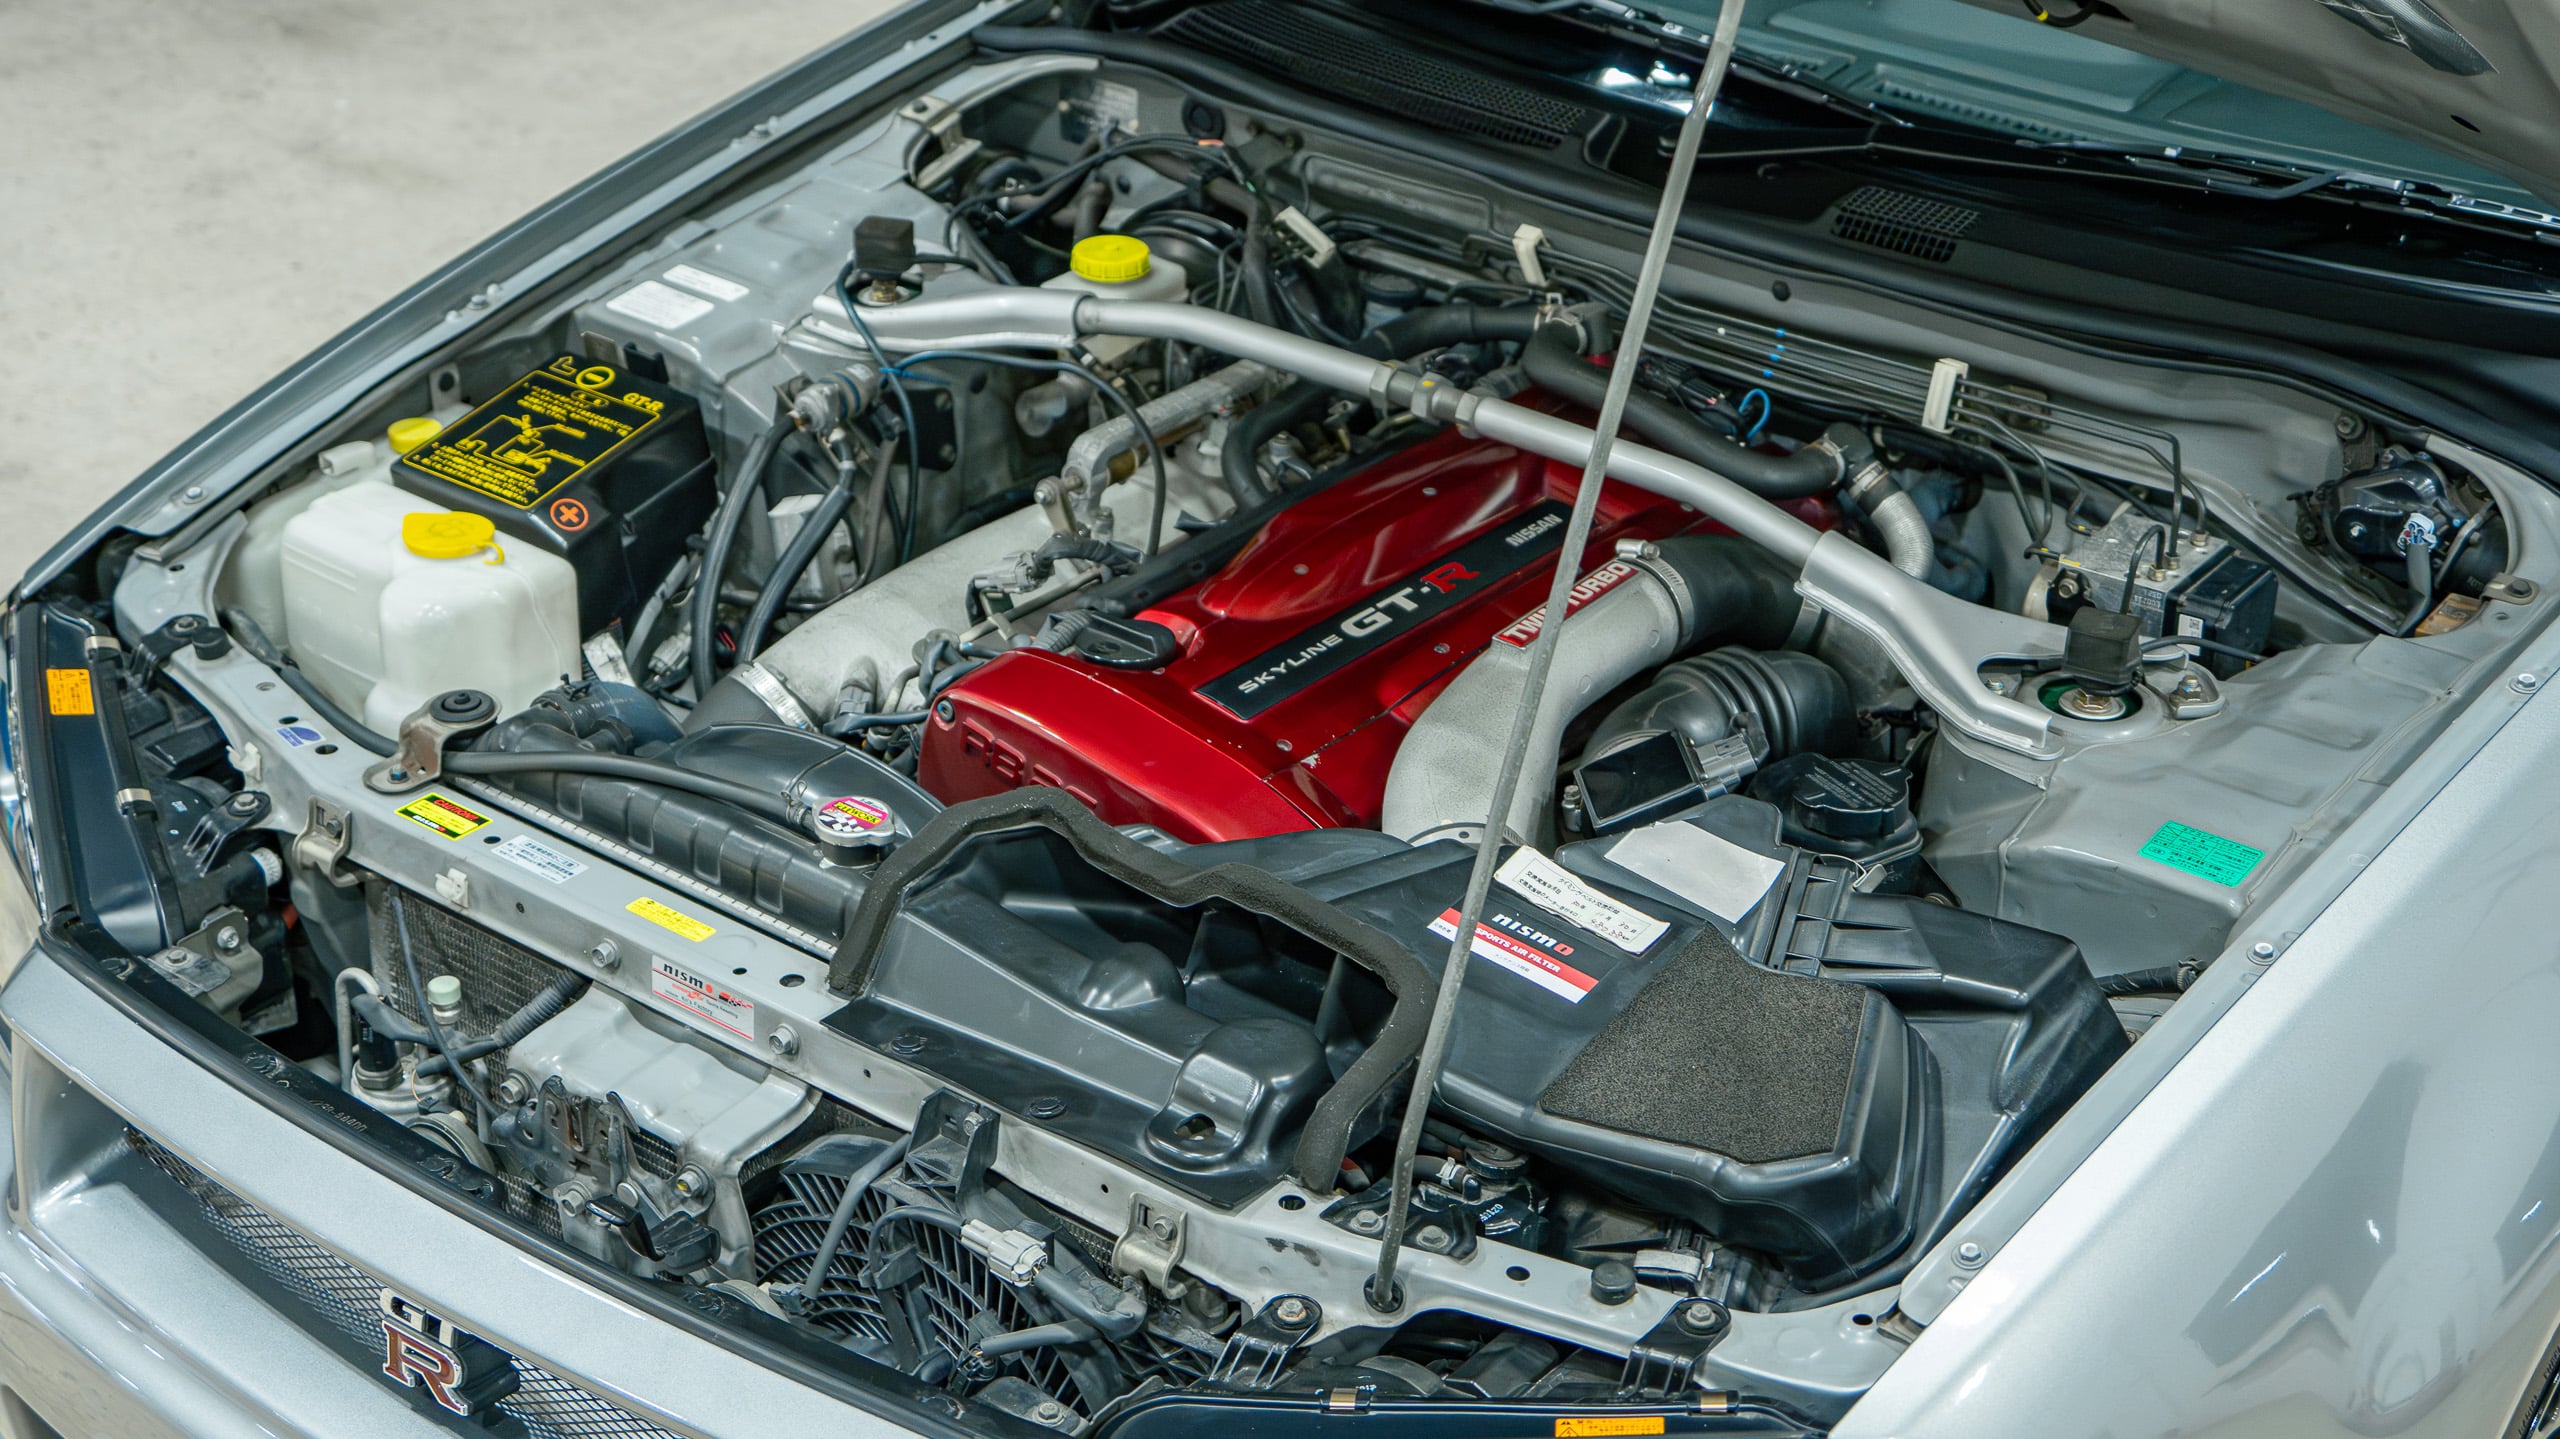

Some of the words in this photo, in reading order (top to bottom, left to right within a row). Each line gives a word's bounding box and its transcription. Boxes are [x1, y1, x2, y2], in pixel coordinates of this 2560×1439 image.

[1505, 513, 1563, 547] NISSAN
[1503, 603, 1551, 640] TWI
[1567, 562, 1632, 607] TURBO
[1239, 634, 1344, 694] SKYLINE
[960, 716, 1099, 806] RB
[412, 815, 446, 832] nismo
[834, 802, 882, 824] PITWORK
[1474, 926, 1511, 949] SPORTS
[1510, 941, 1529, 957] AIR
[1527, 950, 1562, 974] FILTER
[1491, 913, 1576, 957] nismo
[663, 963, 714, 994] nismo
[379, 1287, 455, 1349] GT
[381, 1319, 470, 1417] R
